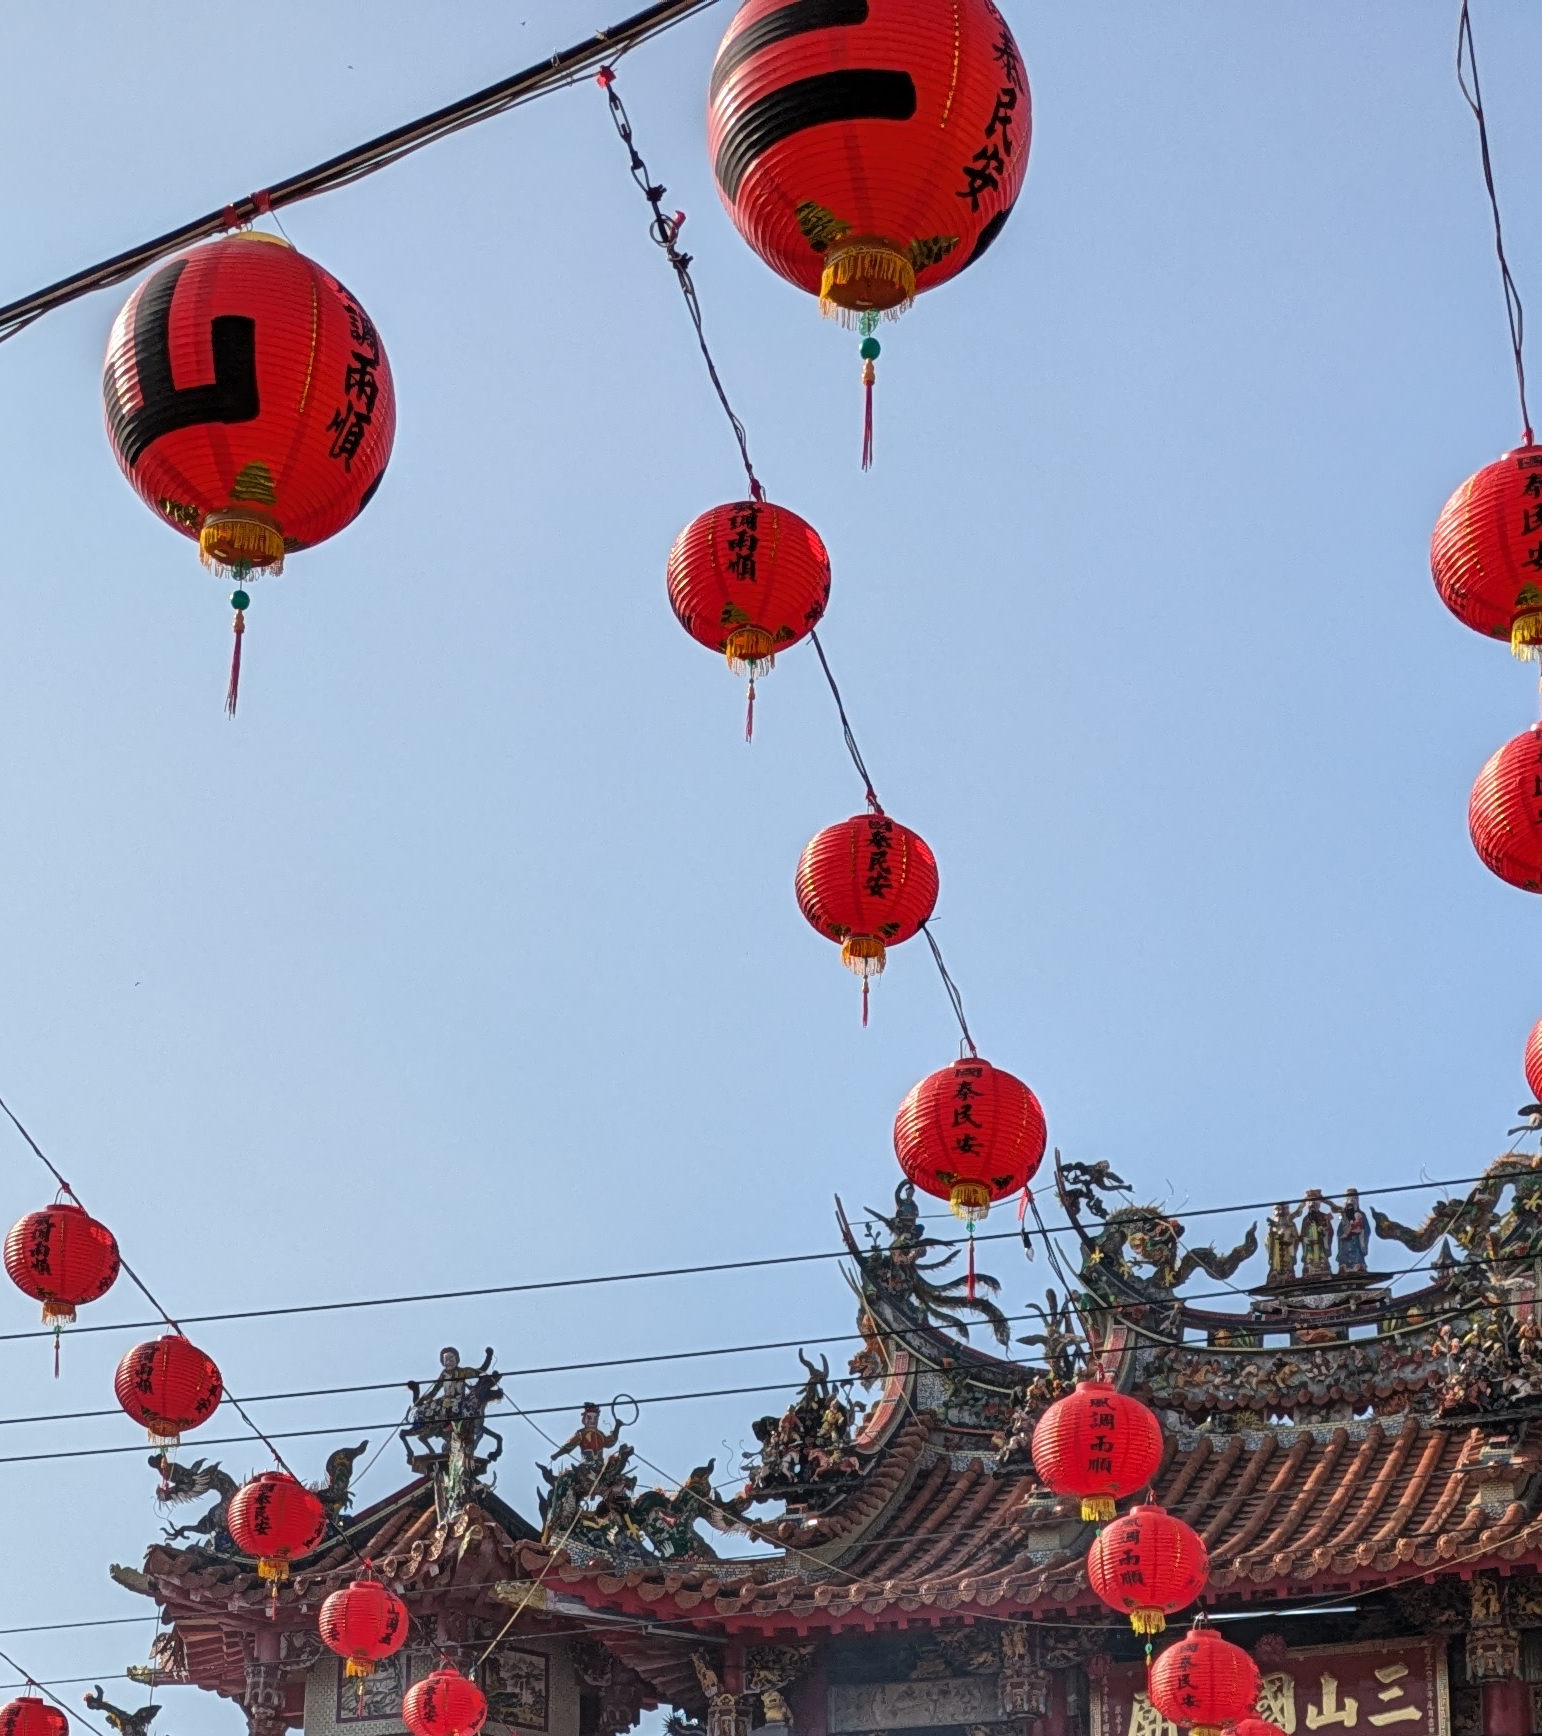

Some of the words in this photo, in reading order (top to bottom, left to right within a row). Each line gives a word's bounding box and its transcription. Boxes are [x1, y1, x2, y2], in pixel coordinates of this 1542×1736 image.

[955, 8, 1025, 213] 泰民安
[326, 288, 380, 474] 調雨順
[861, 819, 894, 899] 國泰民安
[951, 1067, 985, 1157] 國泰民安
[1087, 1398, 1116, 1475] 風調雨順
[1118, 1517, 1144, 1589] 風調雨順
[1177, 1642, 1203, 1709] 國泰民安
